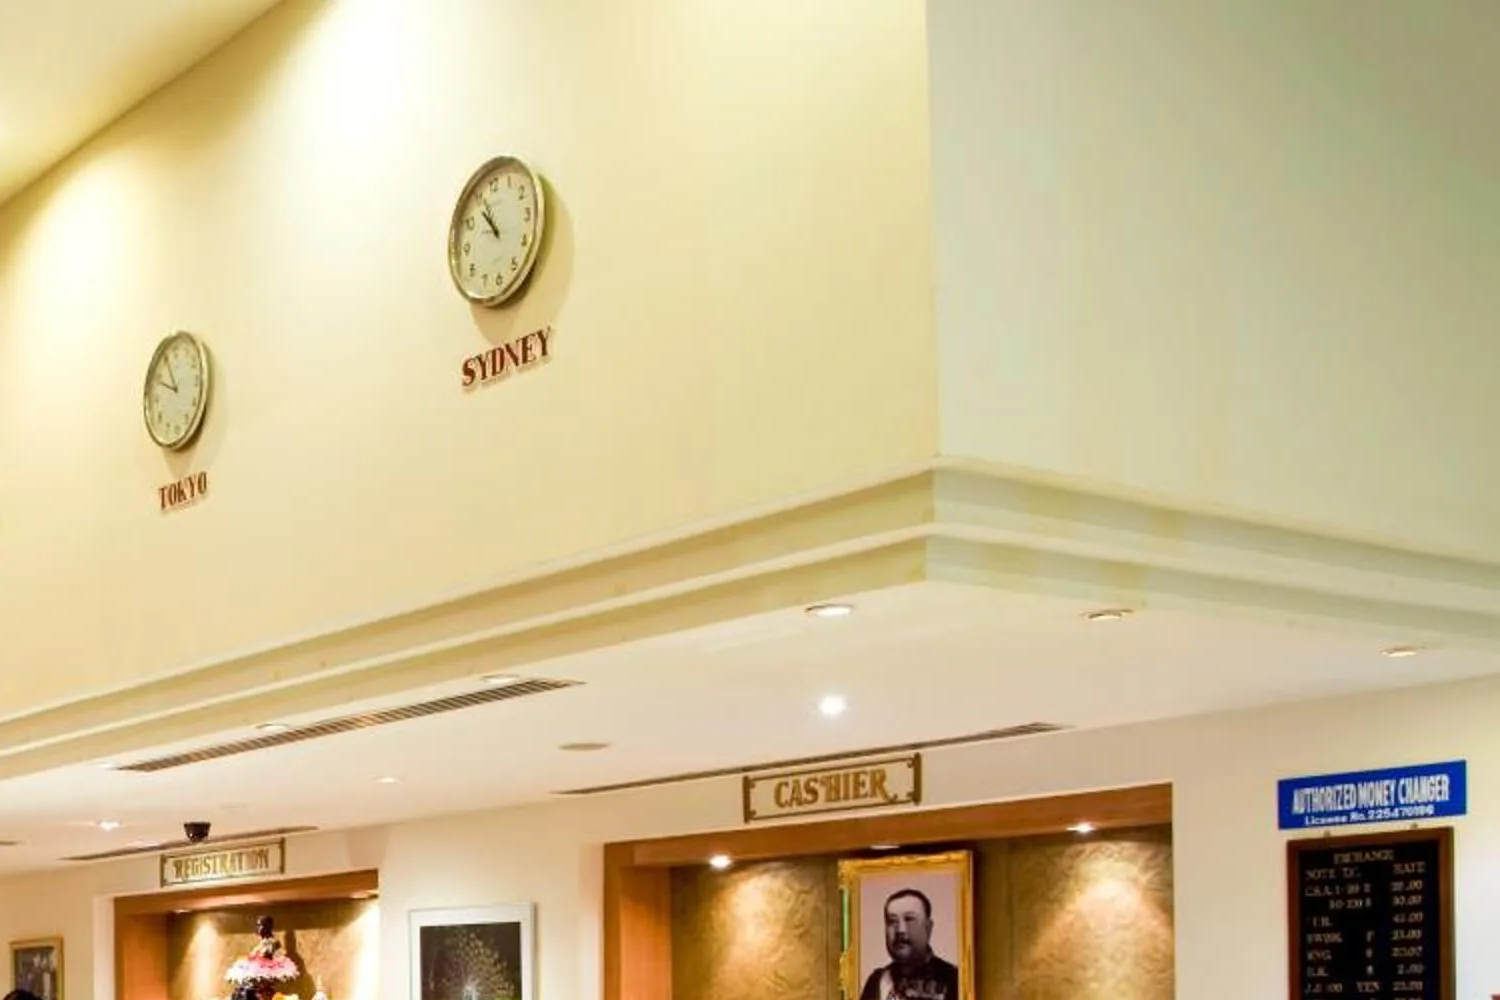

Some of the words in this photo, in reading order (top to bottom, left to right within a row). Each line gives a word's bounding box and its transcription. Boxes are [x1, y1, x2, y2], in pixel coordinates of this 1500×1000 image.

[462, 325, 551, 387] SYDNEY
[159, 471, 207, 510] TOKYO
[773, 768, 898, 809] CASHIER
[1291, 783, 1357, 815] AUTHORIZED
[1357, 779, 1396, 809] MONEY
[1397, 773, 1450, 805] CHANGER
[173, 847, 269, 880] REGISTRATON
